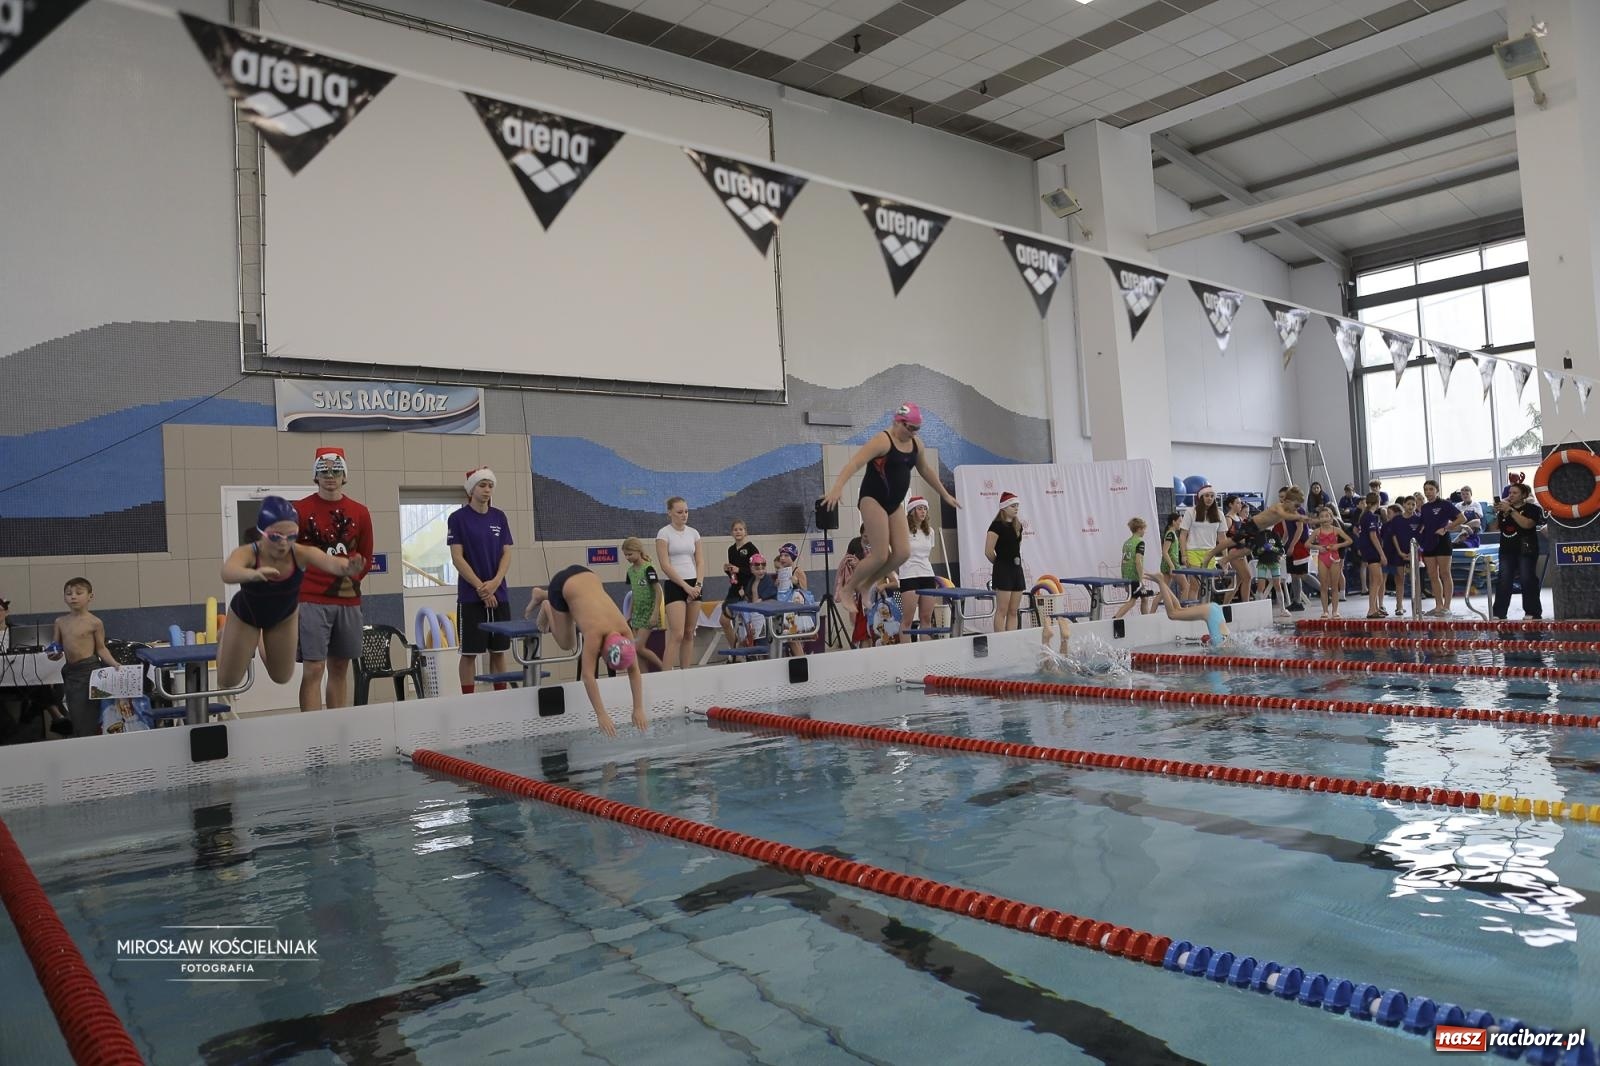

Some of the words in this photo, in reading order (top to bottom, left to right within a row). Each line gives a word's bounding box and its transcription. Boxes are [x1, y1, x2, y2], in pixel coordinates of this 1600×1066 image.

[231, 48, 349, 107] arena
[502, 115, 590, 164] arena
[713, 165, 782, 207] arena
[875, 207, 930, 242] arena
[1015, 242, 1058, 274] arena
[1120, 269, 1155, 296] arena
[312, 390, 353, 410] SMS
[357, 388, 448, 412] RACIBÓRZ
[1572, 555, 1583, 563] 1,8
